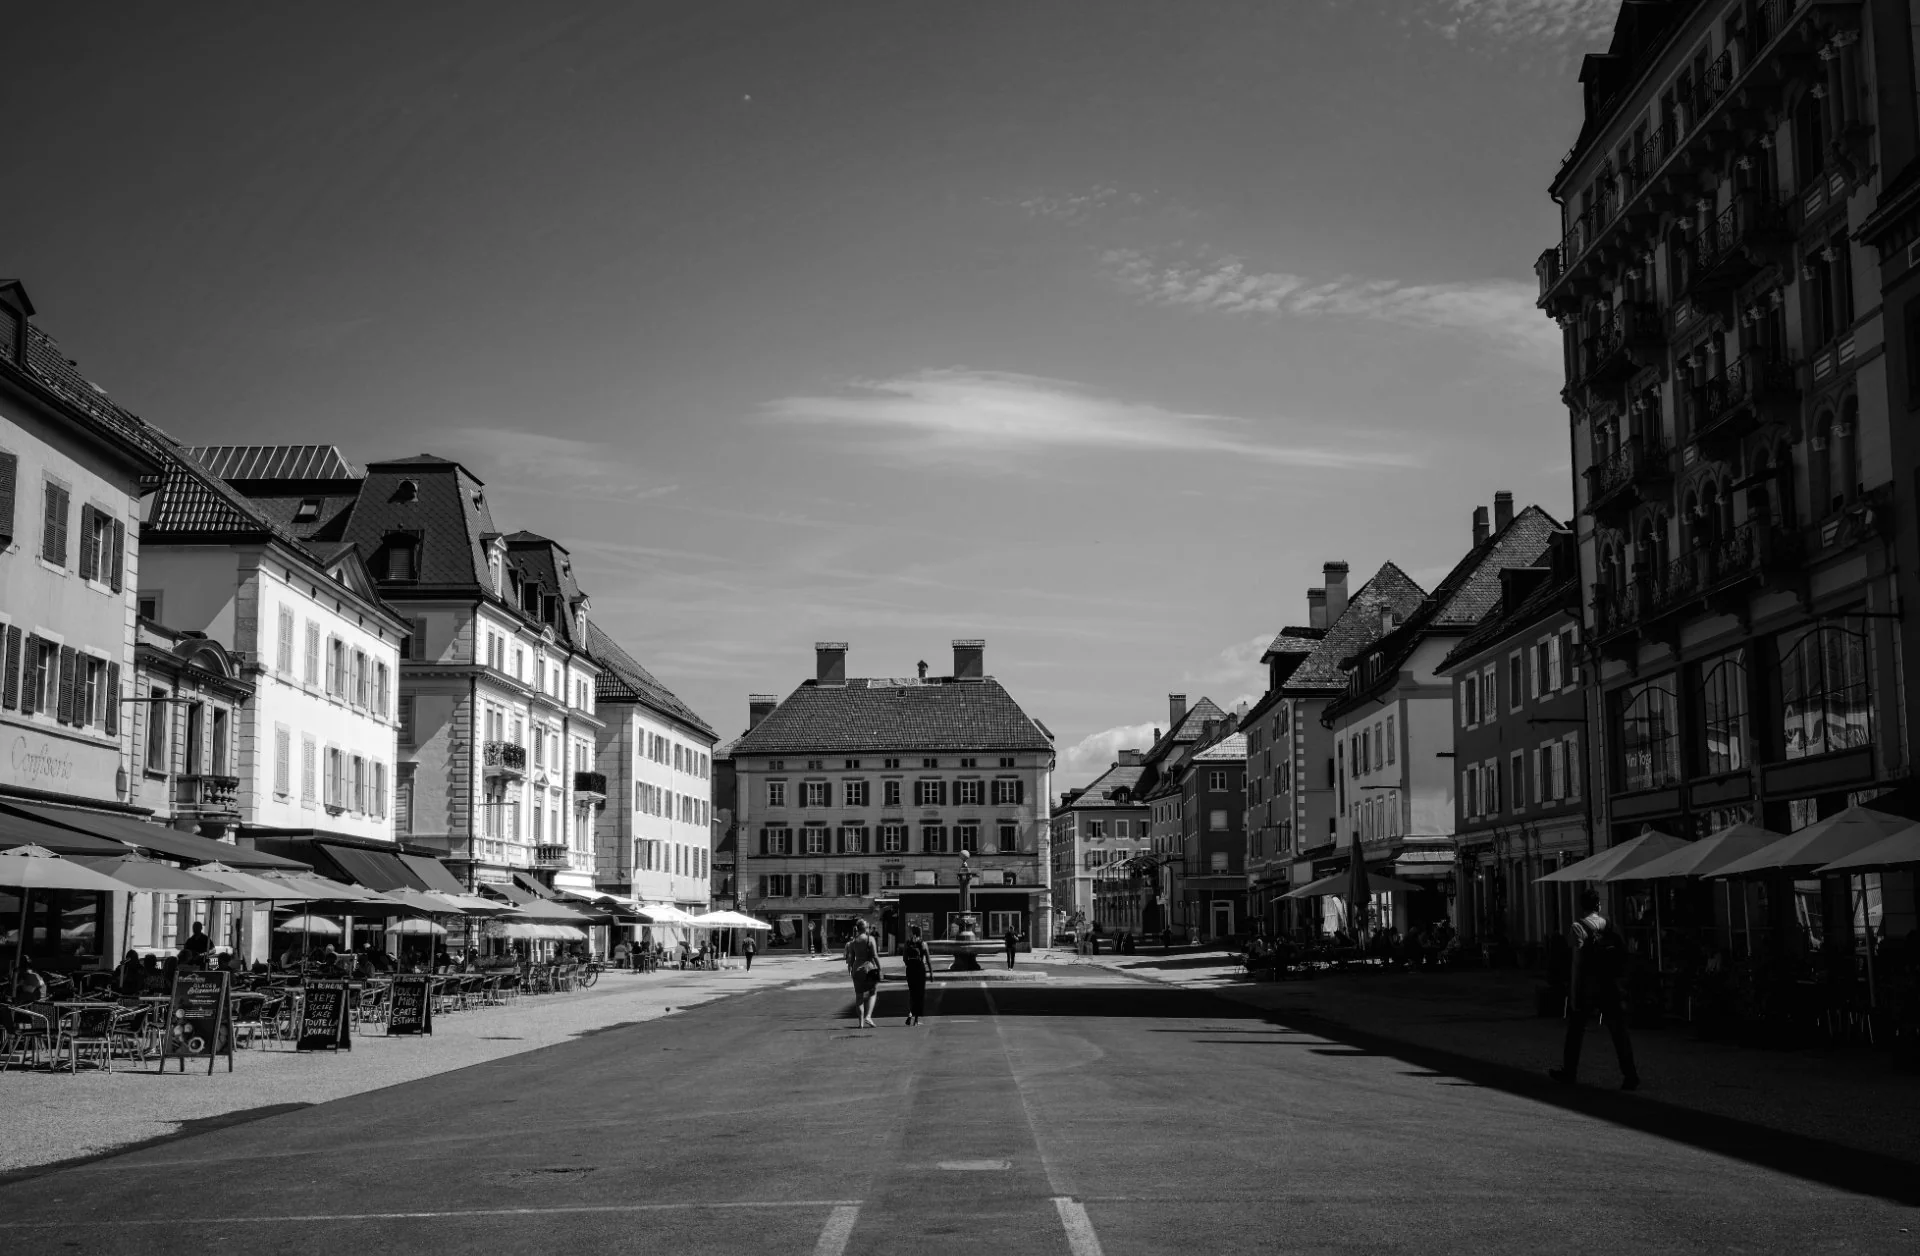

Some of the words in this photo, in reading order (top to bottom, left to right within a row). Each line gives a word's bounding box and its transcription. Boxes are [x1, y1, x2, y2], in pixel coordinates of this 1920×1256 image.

[392, 1007, 417, 1017] CARTE
[304, 1018, 328, 1027] TOUTE
[392, 1016, 422, 1026] ESTIVALE
